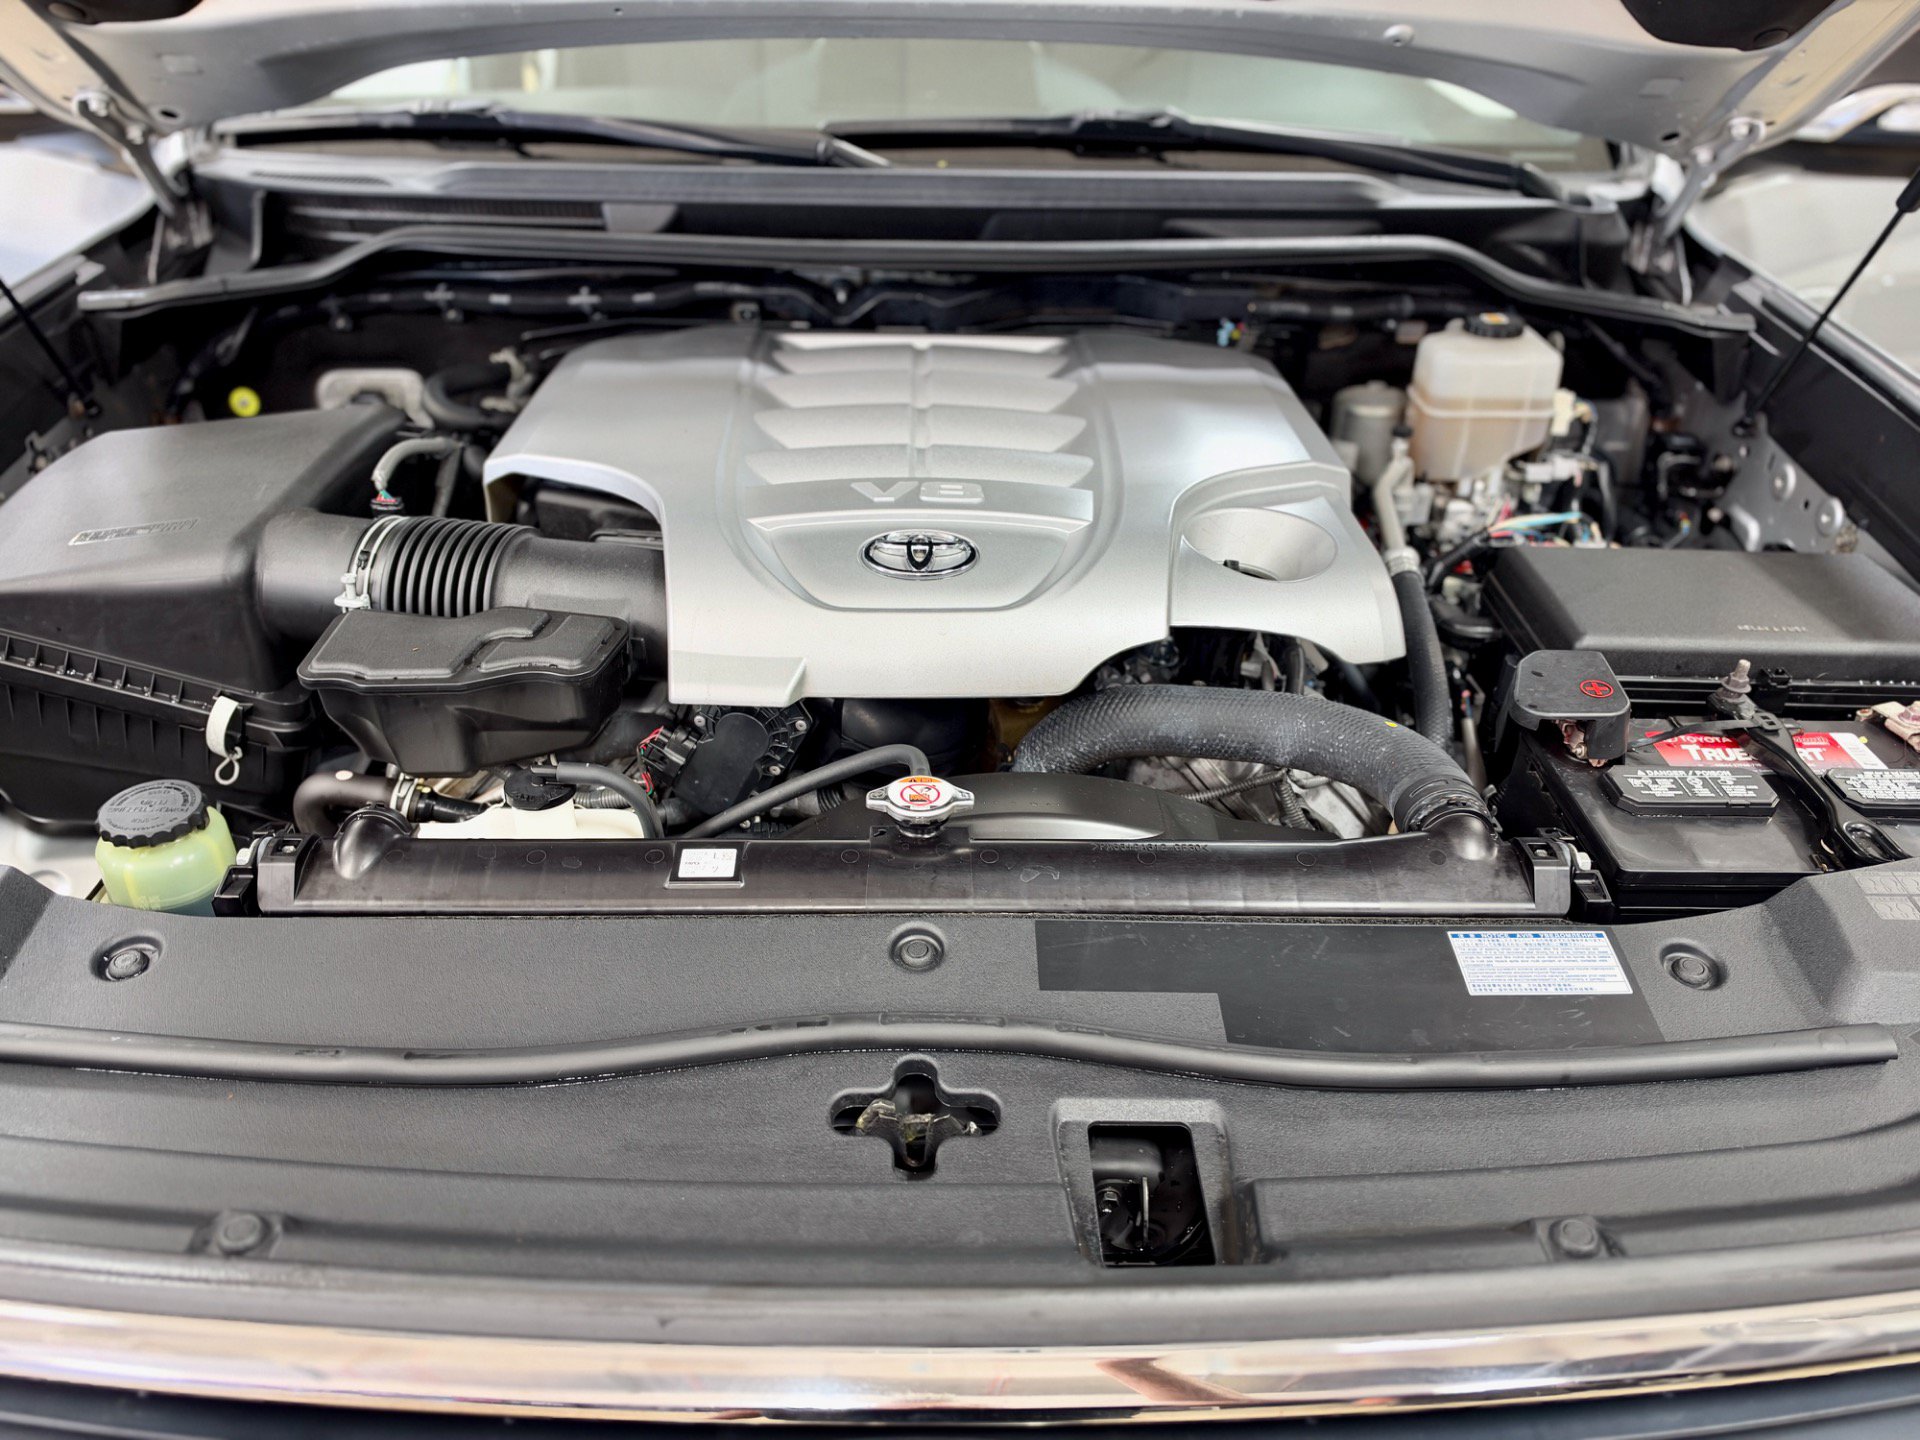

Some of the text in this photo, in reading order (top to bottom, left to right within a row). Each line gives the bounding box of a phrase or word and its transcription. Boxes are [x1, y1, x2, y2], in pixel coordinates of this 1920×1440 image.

[850, 481, 985, 504] V8
[1679, 735, 1732, 744] TOYOTA
[1645, 769, 1687, 777] DANGER
[1695, 769, 1732, 777] POISON
